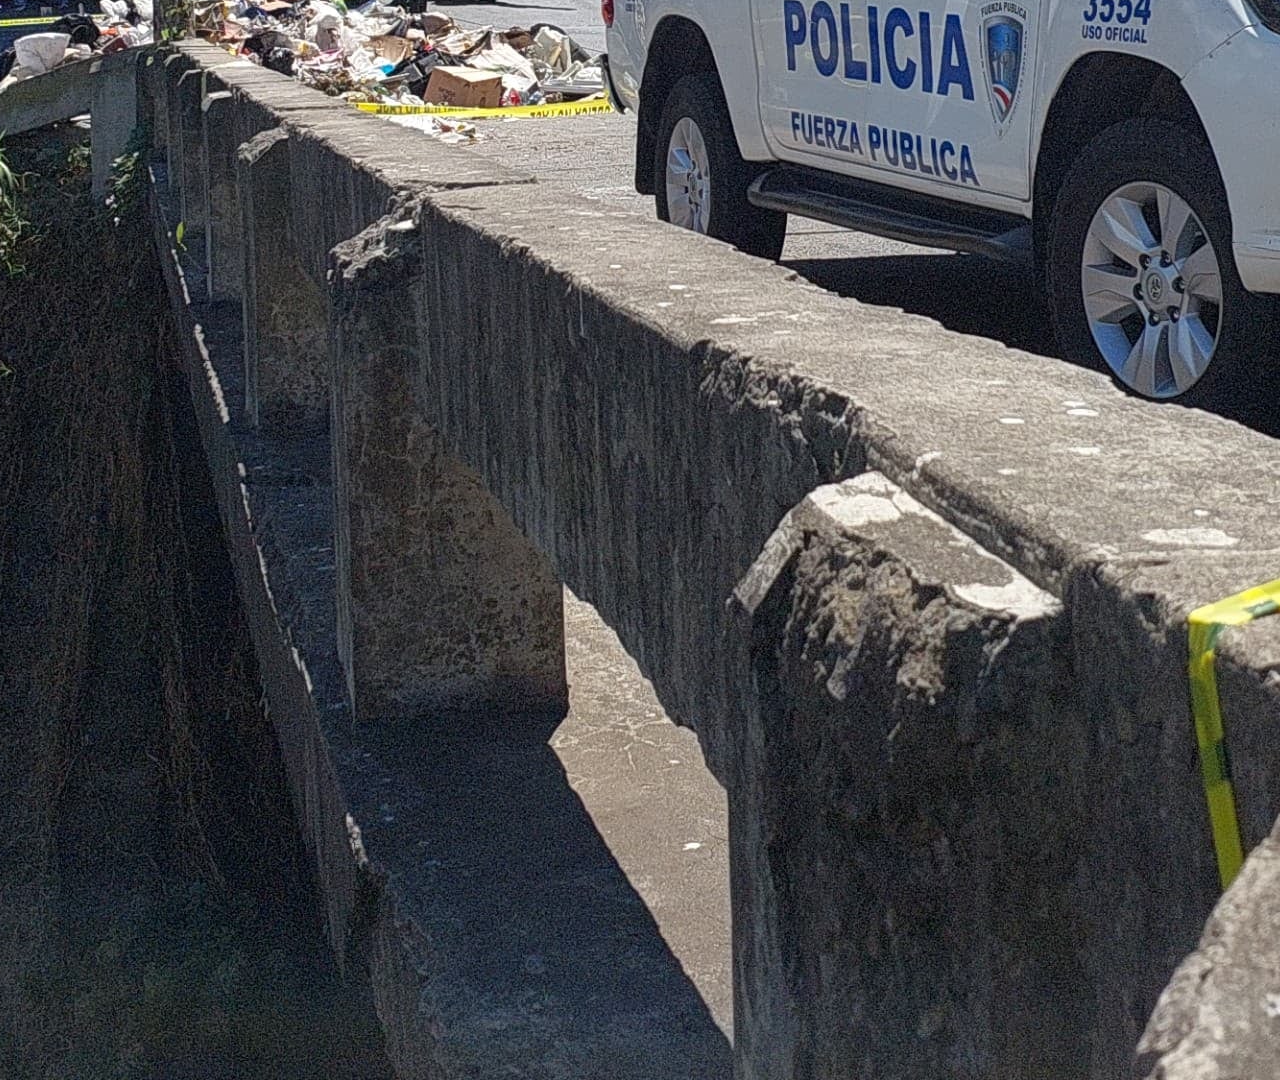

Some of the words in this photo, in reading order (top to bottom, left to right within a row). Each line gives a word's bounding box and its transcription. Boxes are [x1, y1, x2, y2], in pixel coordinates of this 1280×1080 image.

[981, 2, 1003, 17] FUERZA
[1004, 1, 1027, 20] PUBLICA
[1082, 24, 1102, 40] USO
[1105, 26, 1148, 44] OFICIAL
[783, 0, 975, 101] POLICIA
[791, 111, 864, 155] FUERZA
[868, 124, 980, 187] PUBLICA
